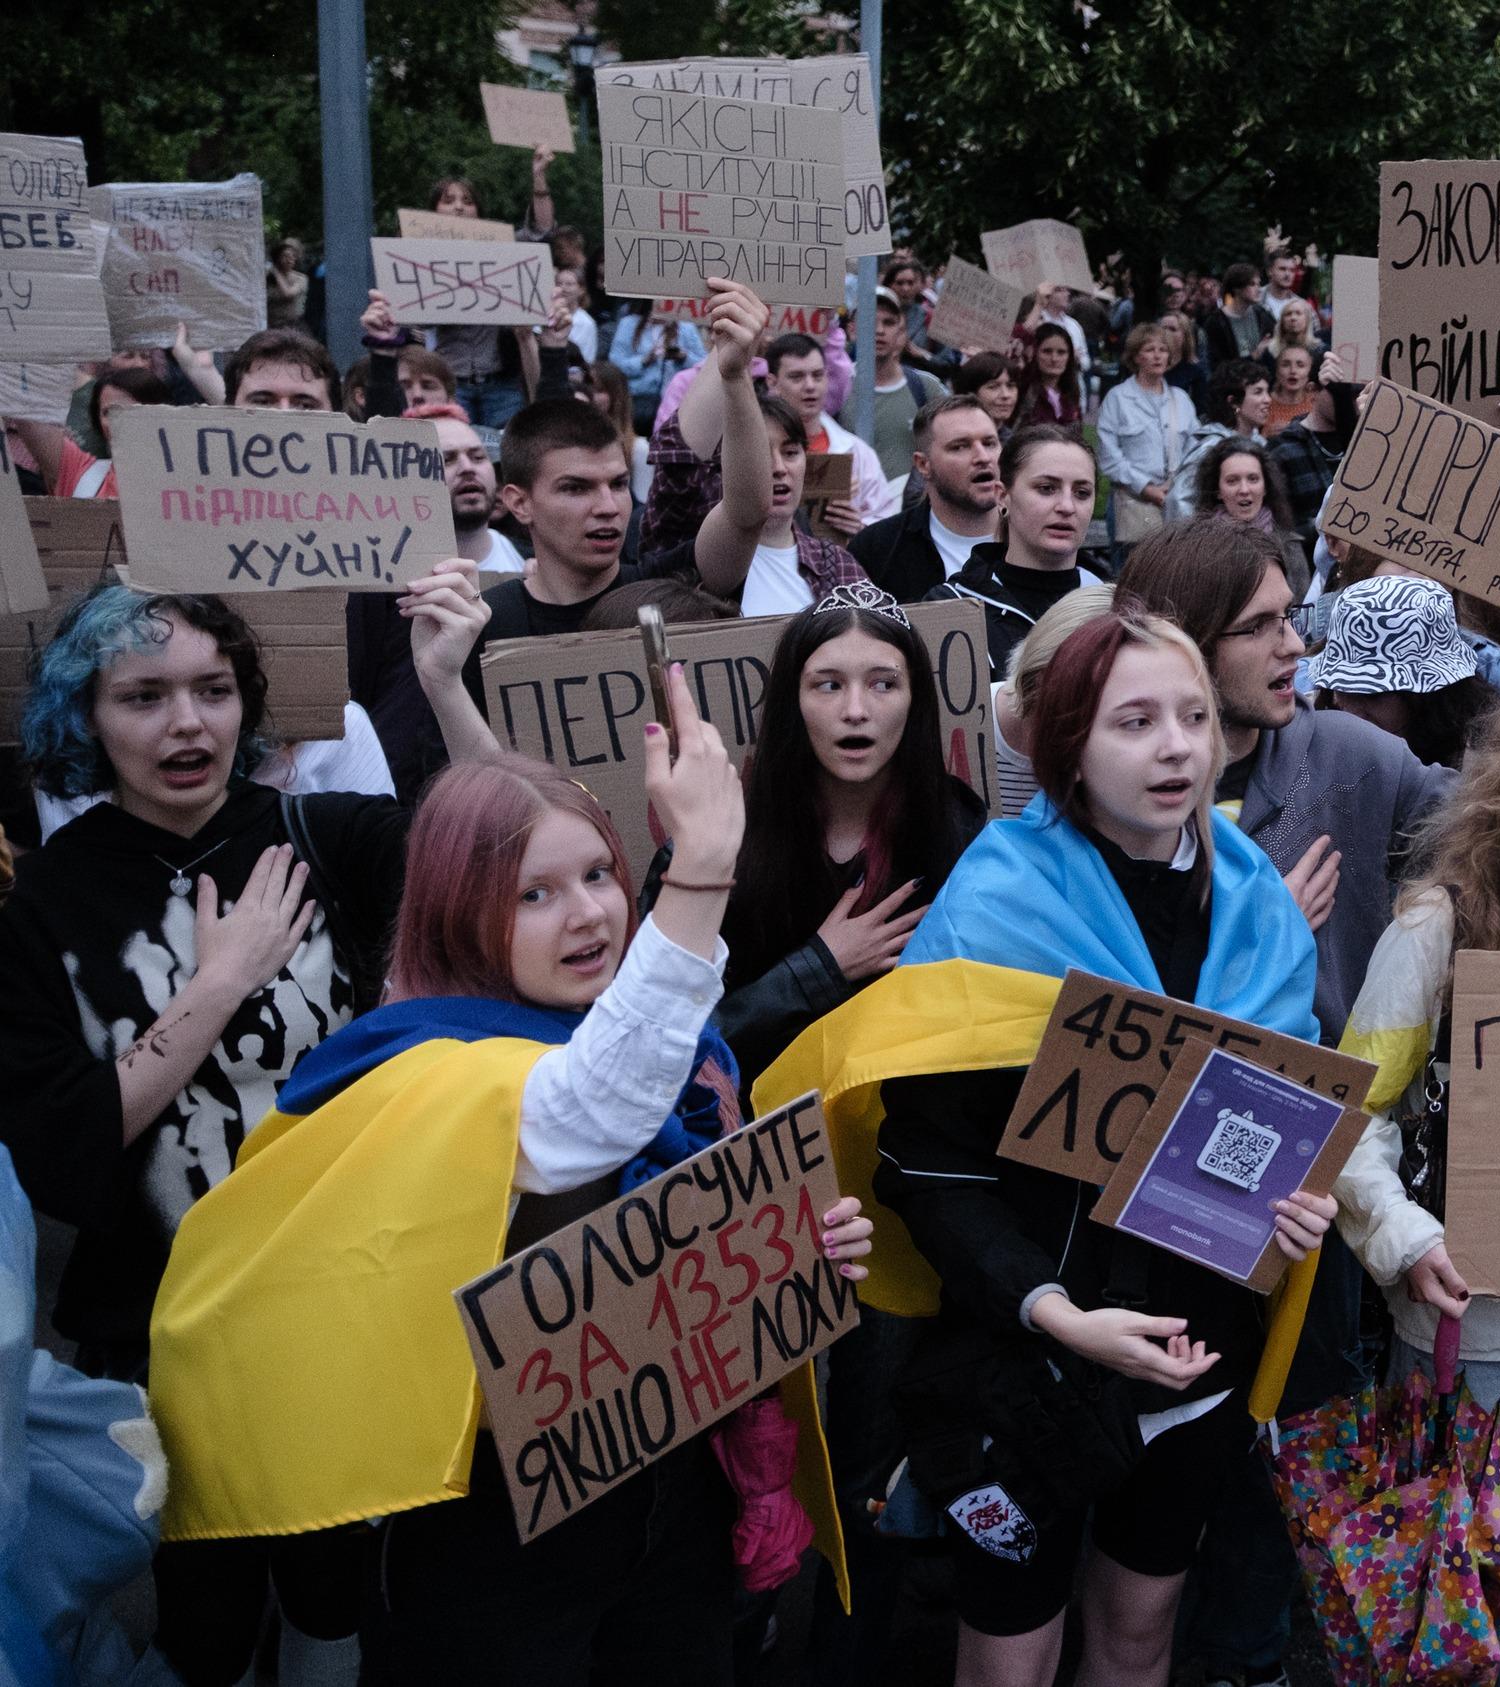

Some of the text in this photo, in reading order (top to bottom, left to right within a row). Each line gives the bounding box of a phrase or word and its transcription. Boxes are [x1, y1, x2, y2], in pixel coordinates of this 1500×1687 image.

[632, 96, 787, 157] ЯКІСНІ
[0, 156, 84, 207] ОЛОВУ
[609, 141, 821, 206] ІНСТИТУЦІЇ,
[611, 189, 843, 246] А НЕ РУЧНЕ
[130, 268, 180, 295] САП
[614, 238, 828, 288] УПРАВЛІННЯ
[1381, 313, 1474, 406] СВІЙ
[158, 427, 174, 473] І
[1329, 497, 1369, 535] ДО
[460, 1099, 826, 1371] ГОЛОСУЙТЕ
[516, 1183, 825, 1428] ЗА 13531
[515, 1256, 859, 1534] ЯКЩО НЕ ЛОХИ
[966, 1499, 1003, 1528] FREE
